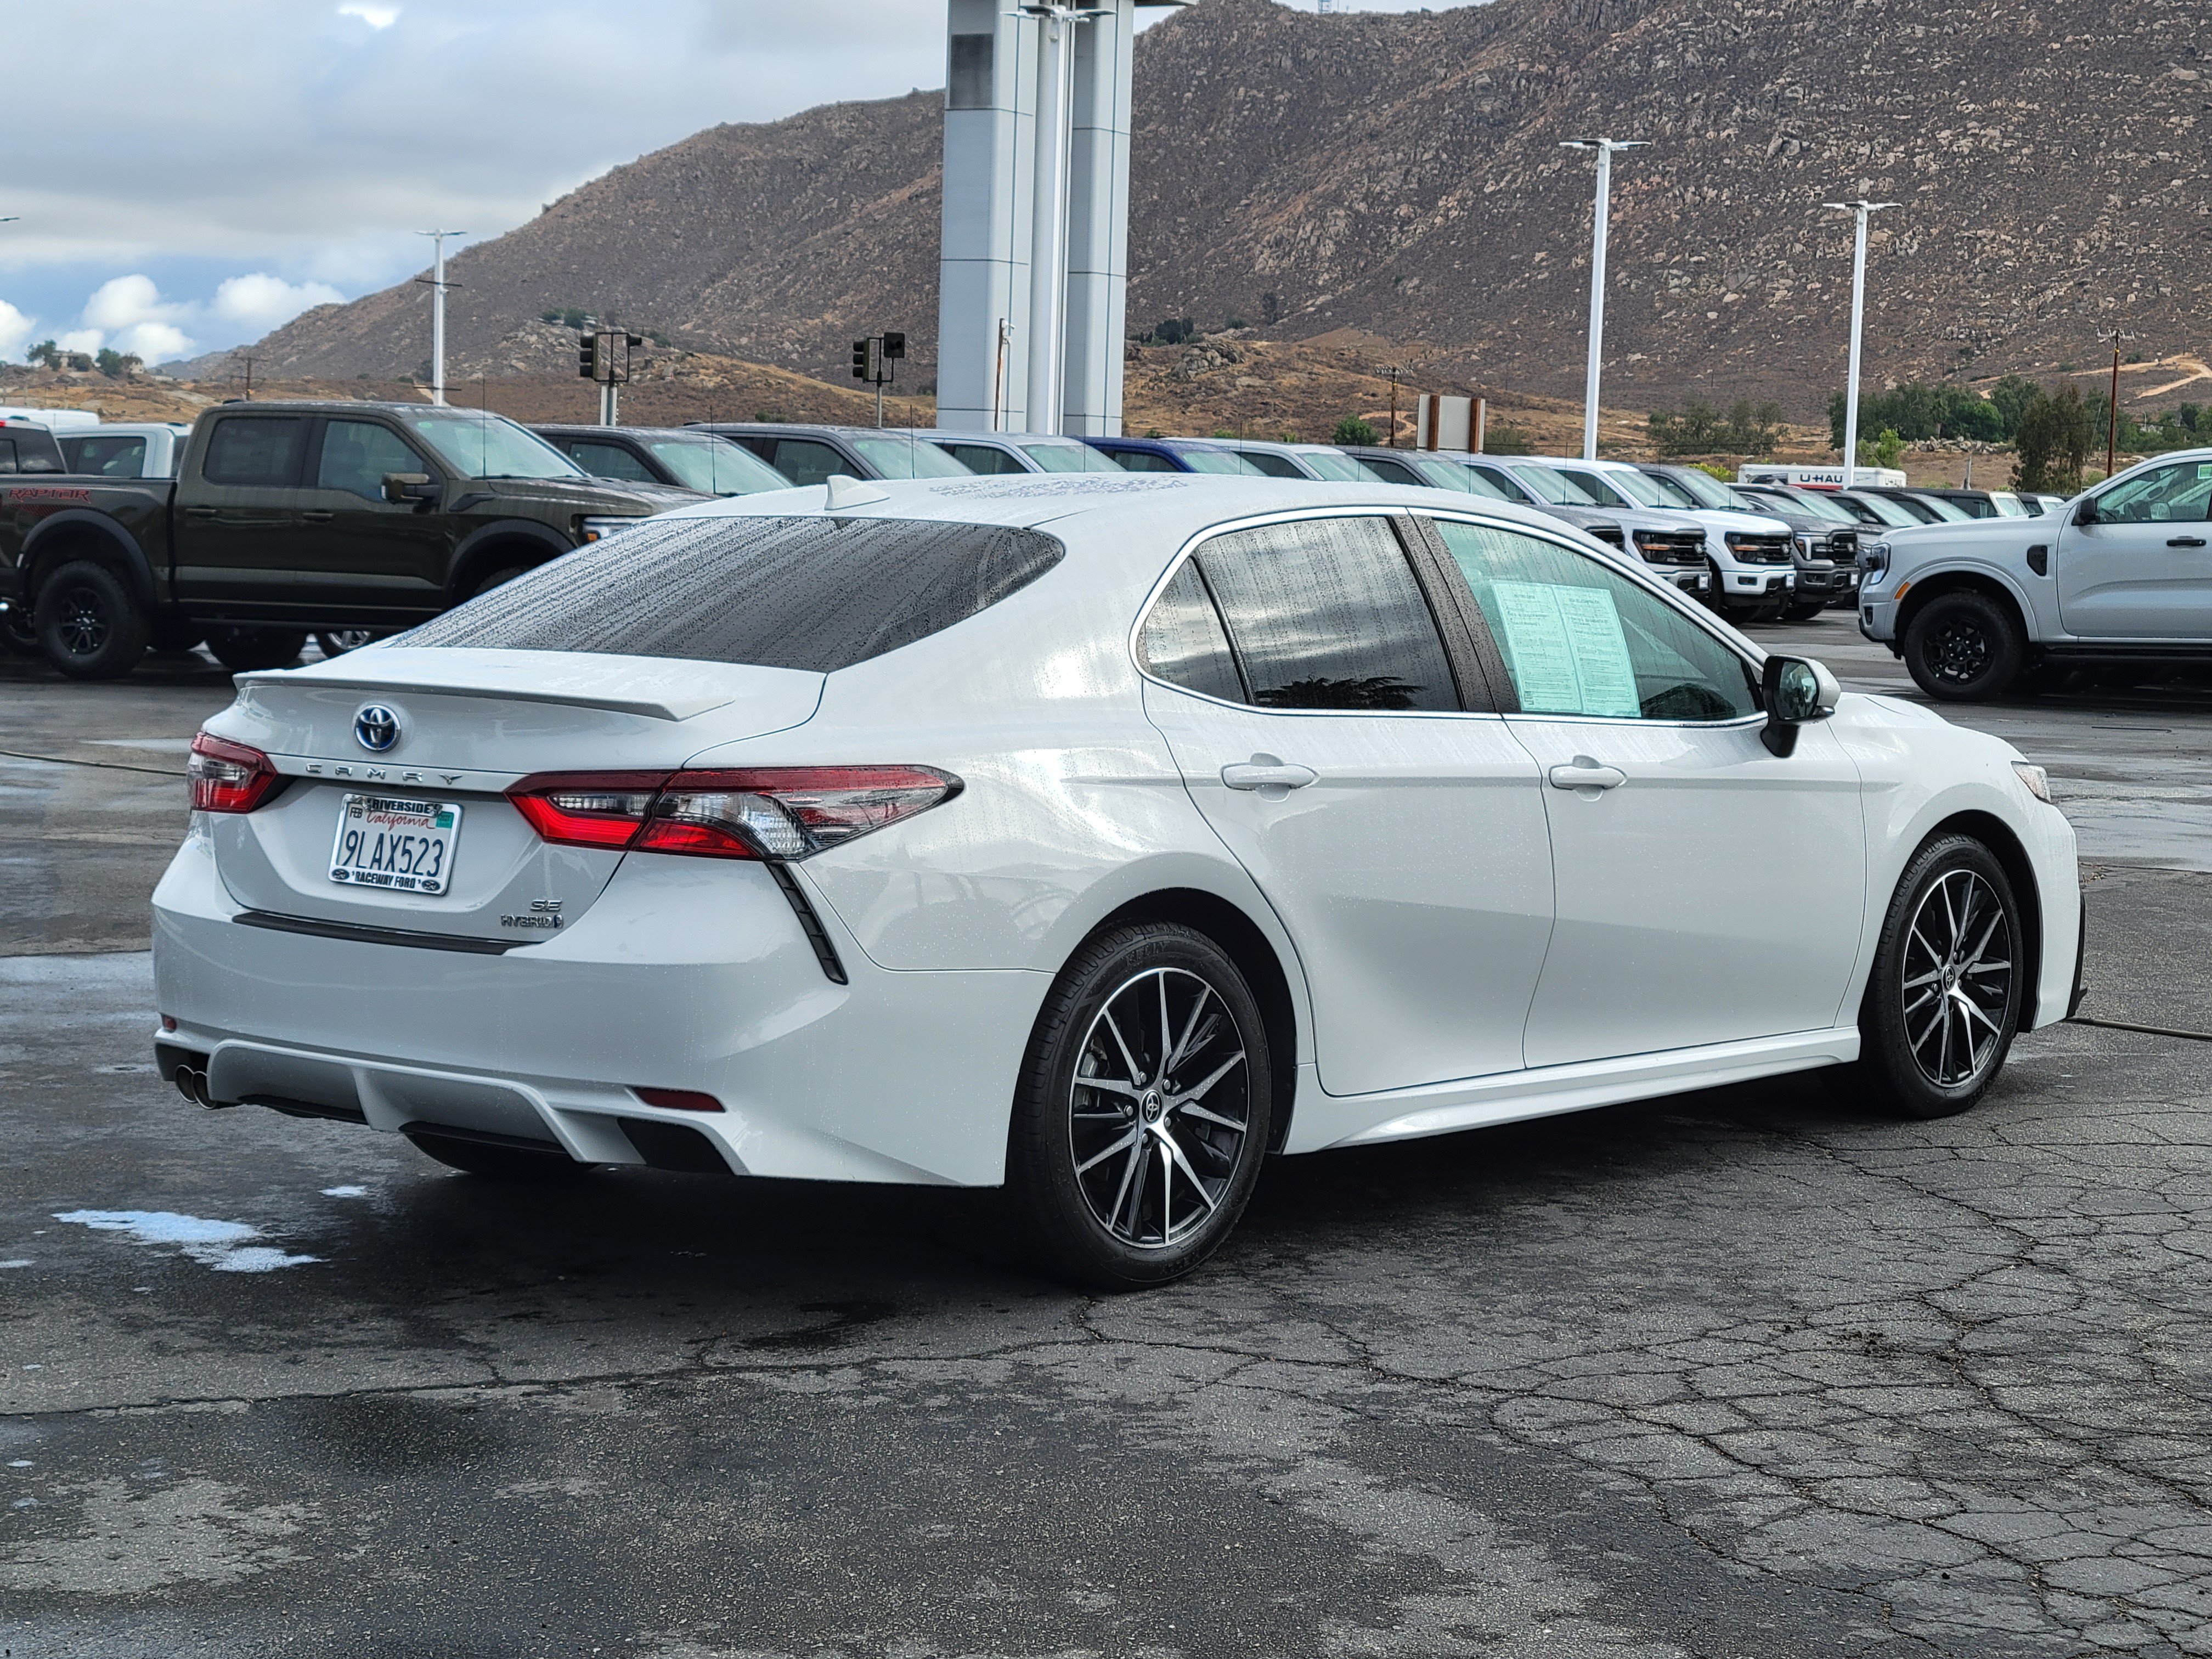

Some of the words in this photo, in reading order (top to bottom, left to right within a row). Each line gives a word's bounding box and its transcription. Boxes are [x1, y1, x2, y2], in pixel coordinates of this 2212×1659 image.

[1799, 473, 1843, 483] U-HAU
[9, 488, 92, 505] RAPTOR
[306, 763, 464, 785] CAMRY
[366, 811, 436, 831] California
[341, 830, 444, 877] 9LAX523
[529, 900, 562, 912] SE
[500, 914, 554, 928] HYBRID
